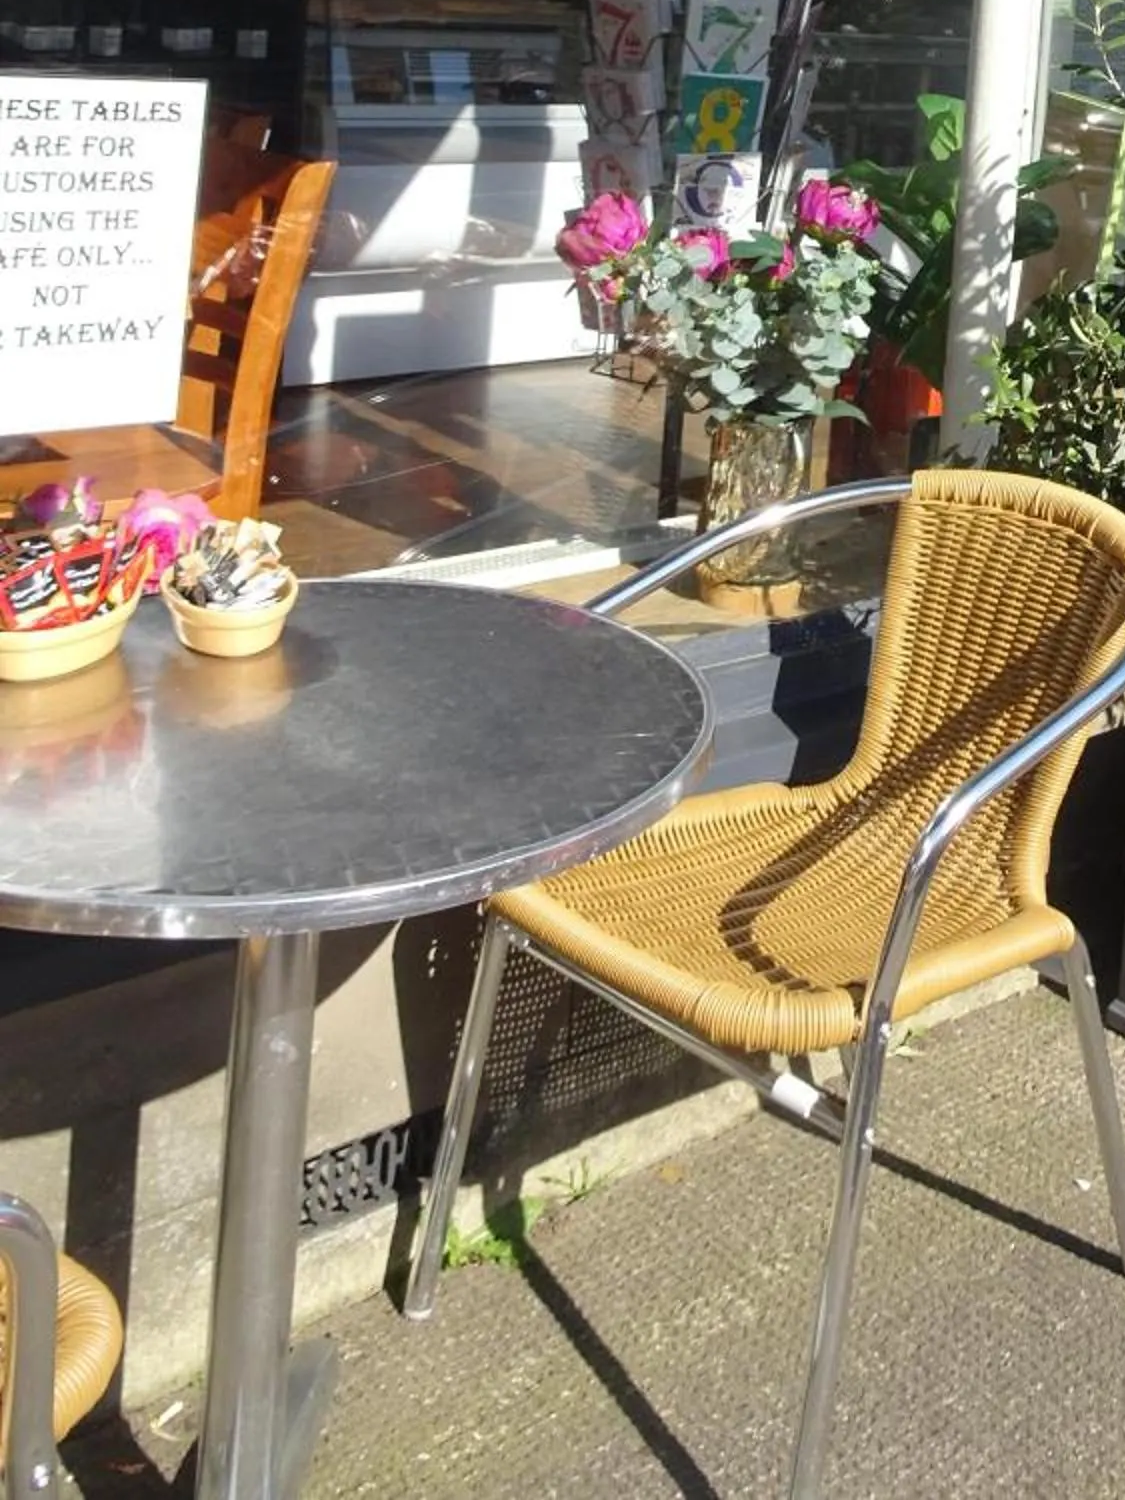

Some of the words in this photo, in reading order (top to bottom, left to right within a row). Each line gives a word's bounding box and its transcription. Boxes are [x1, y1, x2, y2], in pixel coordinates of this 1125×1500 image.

[0, 99, 60, 121] ESE
[72, 100, 182, 123] TABLES
[10, 135, 71, 158] ARE
[82, 135, 135, 158] FOR
[0, 170, 155, 193] USTOMERS
[86, 209, 140, 232] THE
[57, 241, 153, 268] ONLY...
[33, 284, 89, 307] NOT
[15, 315, 164, 348] TAKEWAY
